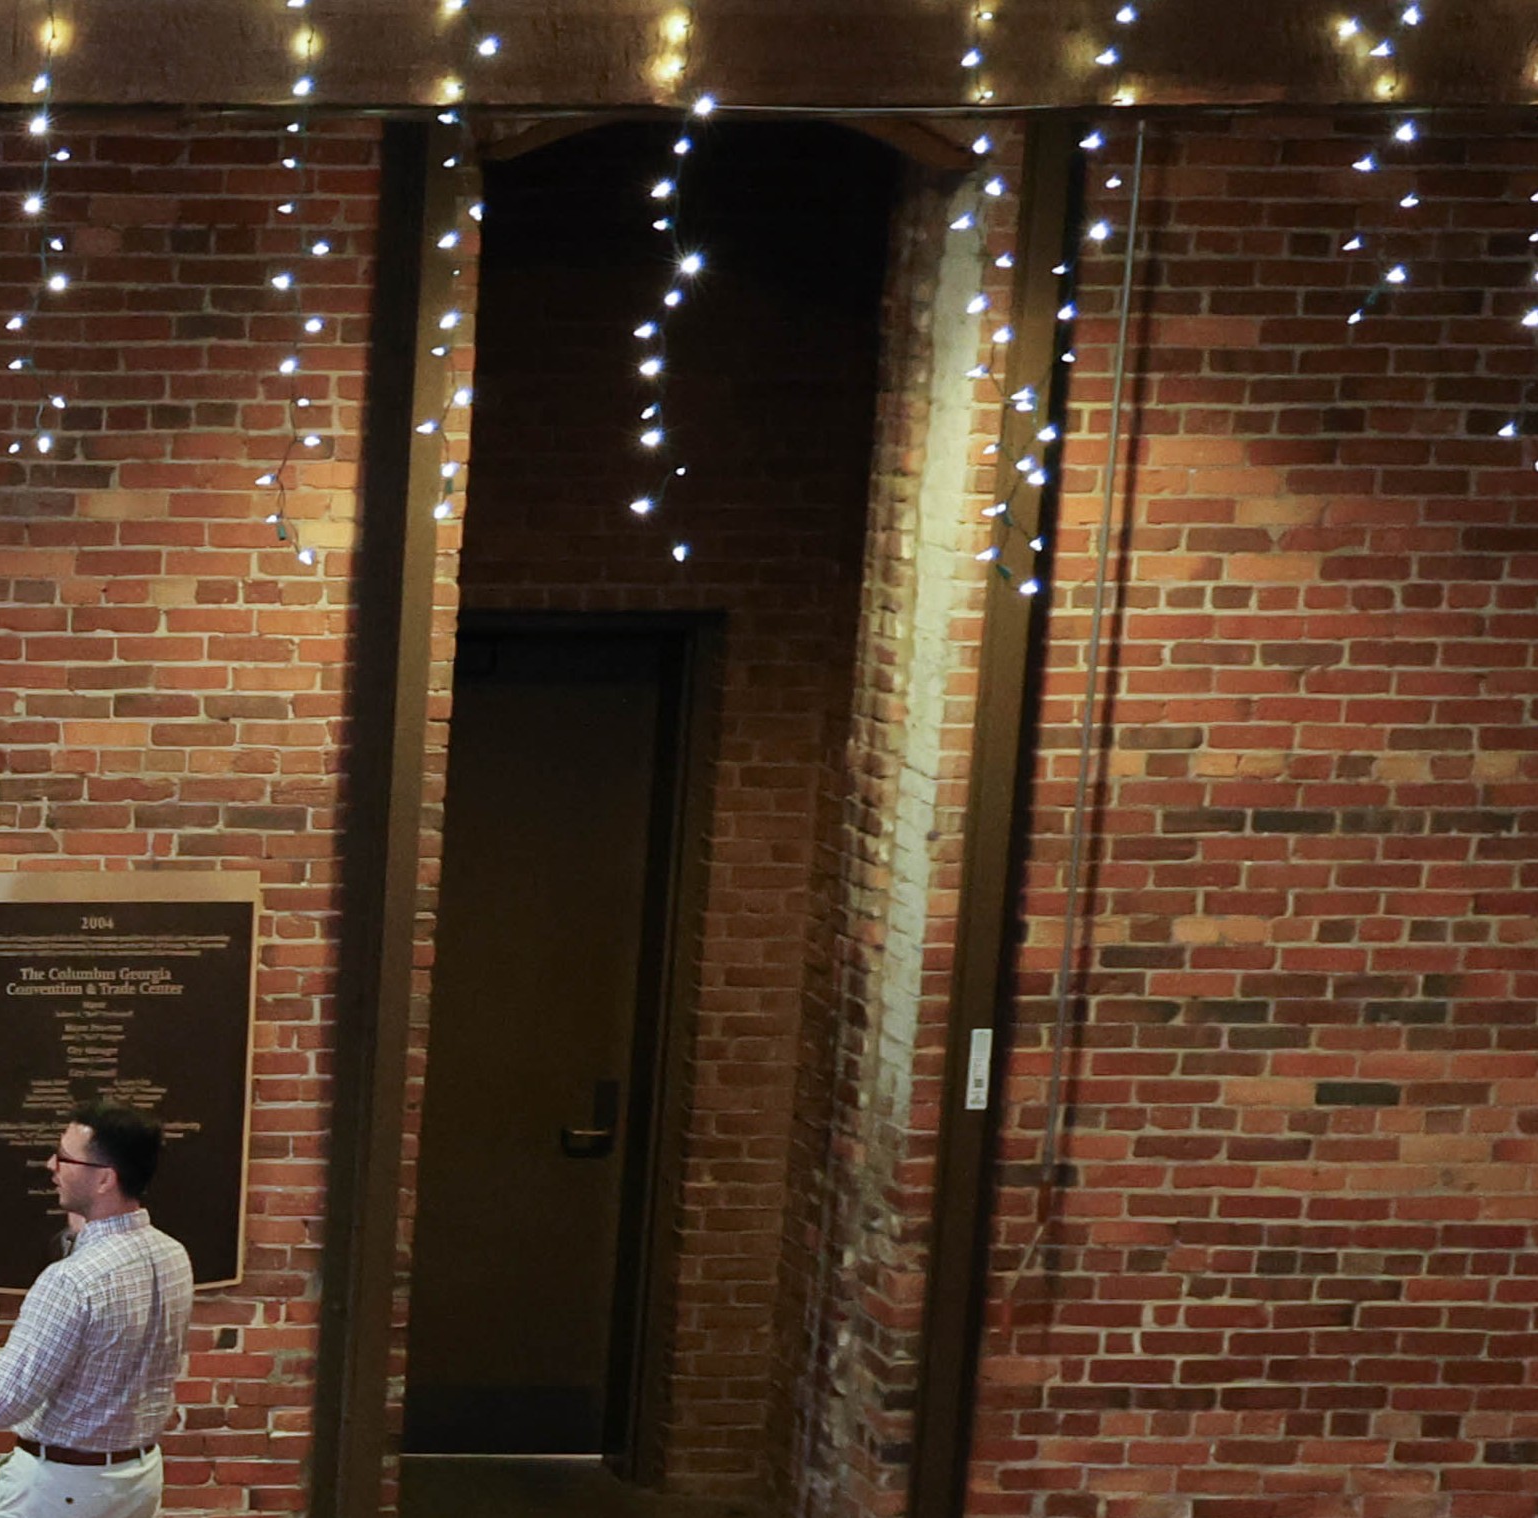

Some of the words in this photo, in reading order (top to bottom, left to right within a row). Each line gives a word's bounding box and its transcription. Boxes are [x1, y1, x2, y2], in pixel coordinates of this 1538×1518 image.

[80, 916, 114, 930] 2004
[20, 967, 45, 980] The
[48, 966, 116, 980] Columbus
[119, 966, 171, 984] Georgia
[6, 982, 83, 995] Convention
[99, 981, 136, 995] Trade
[139, 982, 184, 995] Center
